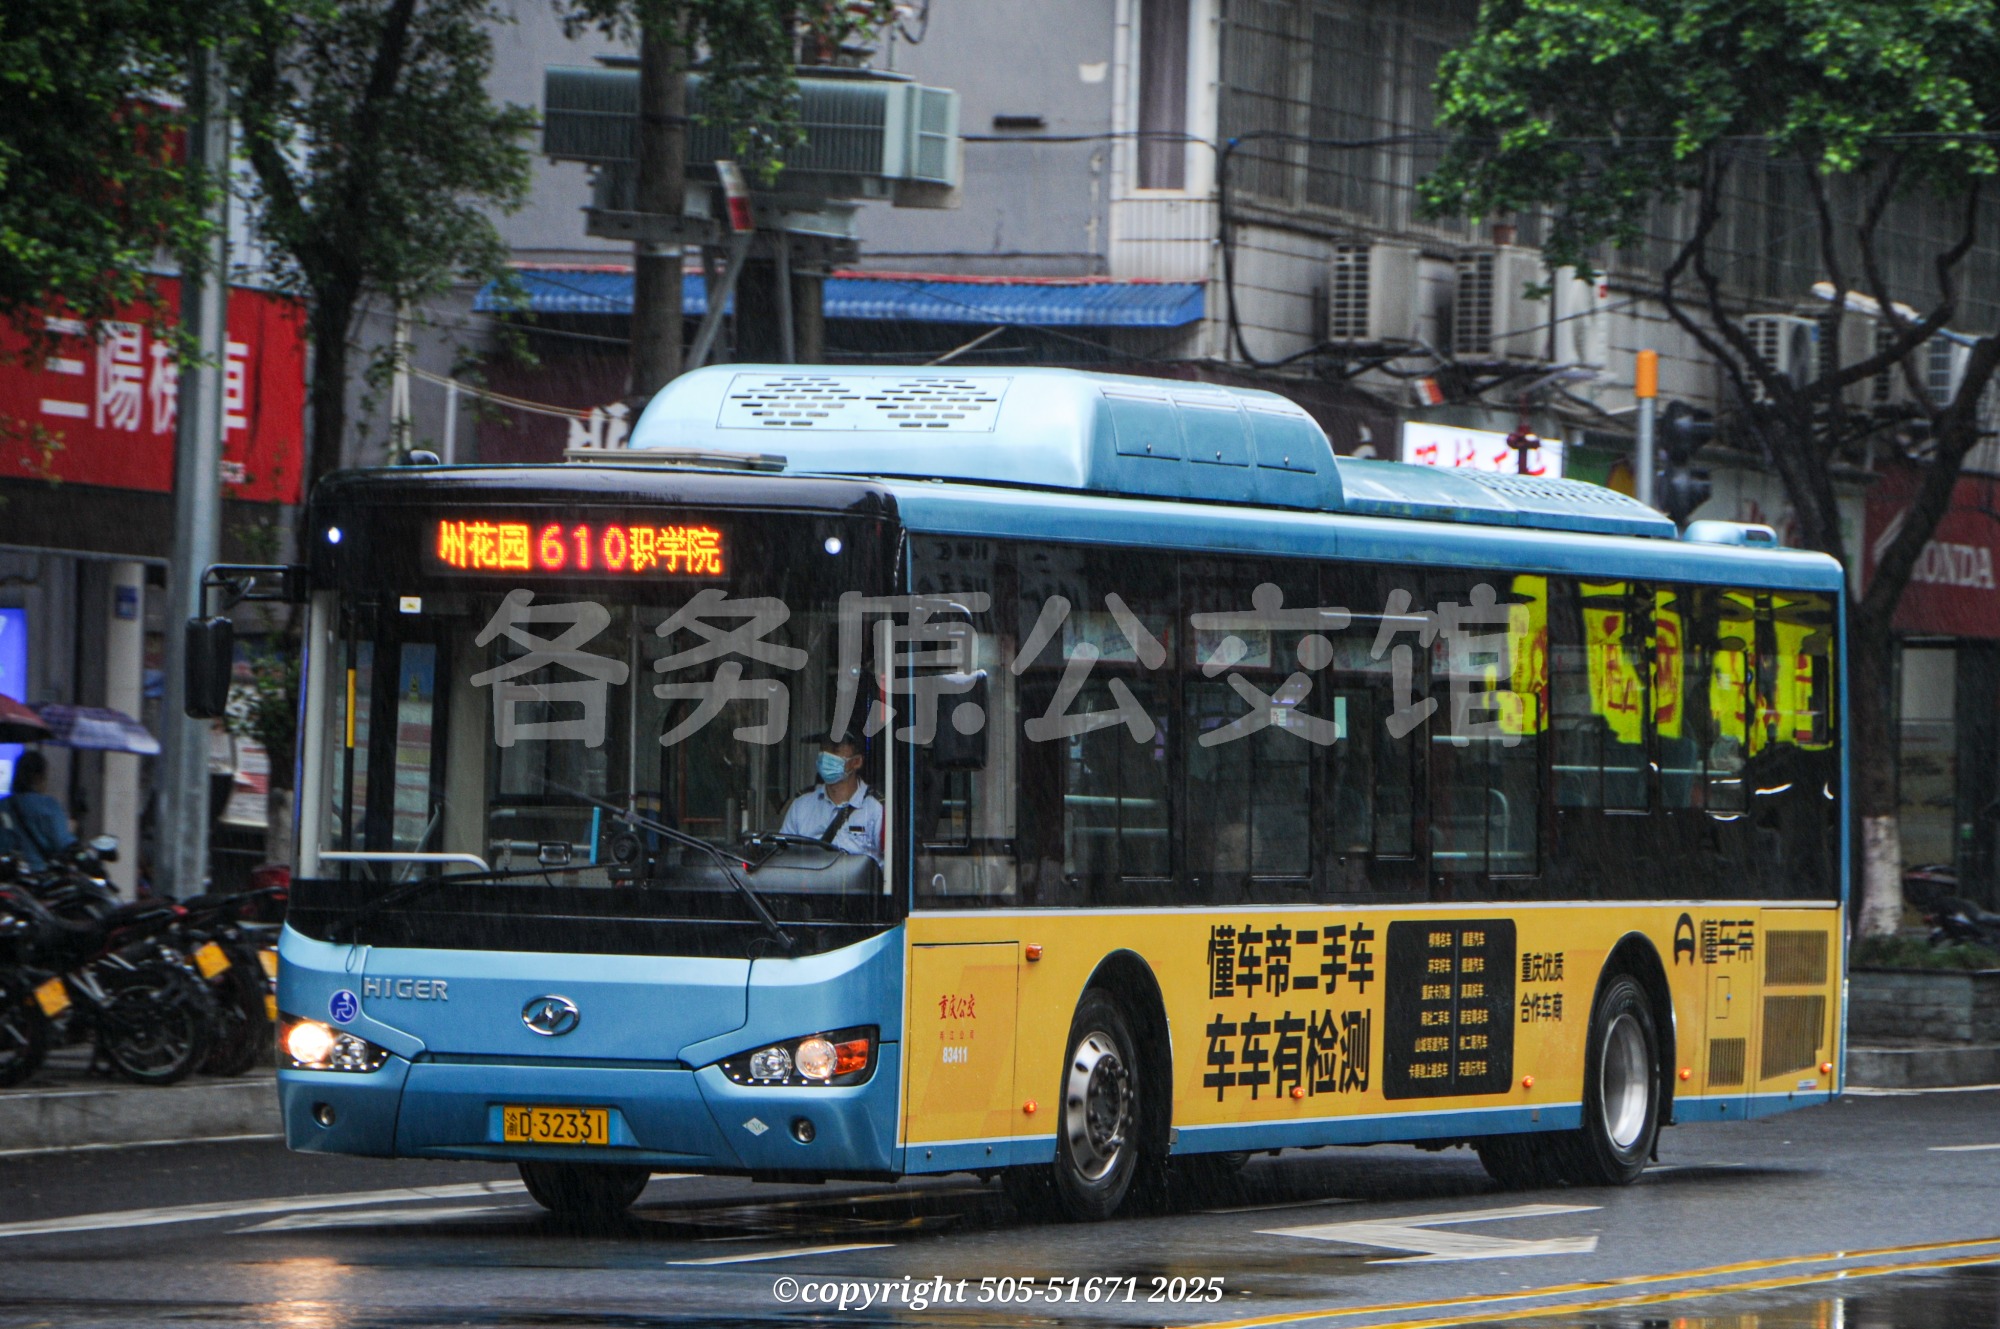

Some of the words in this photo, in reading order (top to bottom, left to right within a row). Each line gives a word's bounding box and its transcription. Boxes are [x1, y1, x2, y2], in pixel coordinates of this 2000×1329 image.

[439, 520, 529, 570] 州花园
[540, 523, 626, 571] 610
[629, 525, 721, 574] 职学院
[1911, 539, 1996, 590] ONDA
[1207, 922, 1375, 1000] 懂车帝二手车
[1700, 919, 1755, 964] 懂车帝
[363, 977, 449, 1001] HIGER
[1521, 952, 1564, 983] 重庆优质
[1520, 992, 1563, 1023] 合作车商
[943, 1047, 968, 1063] 83411
[1203, 1008, 1372, 1102] 车车有检测
